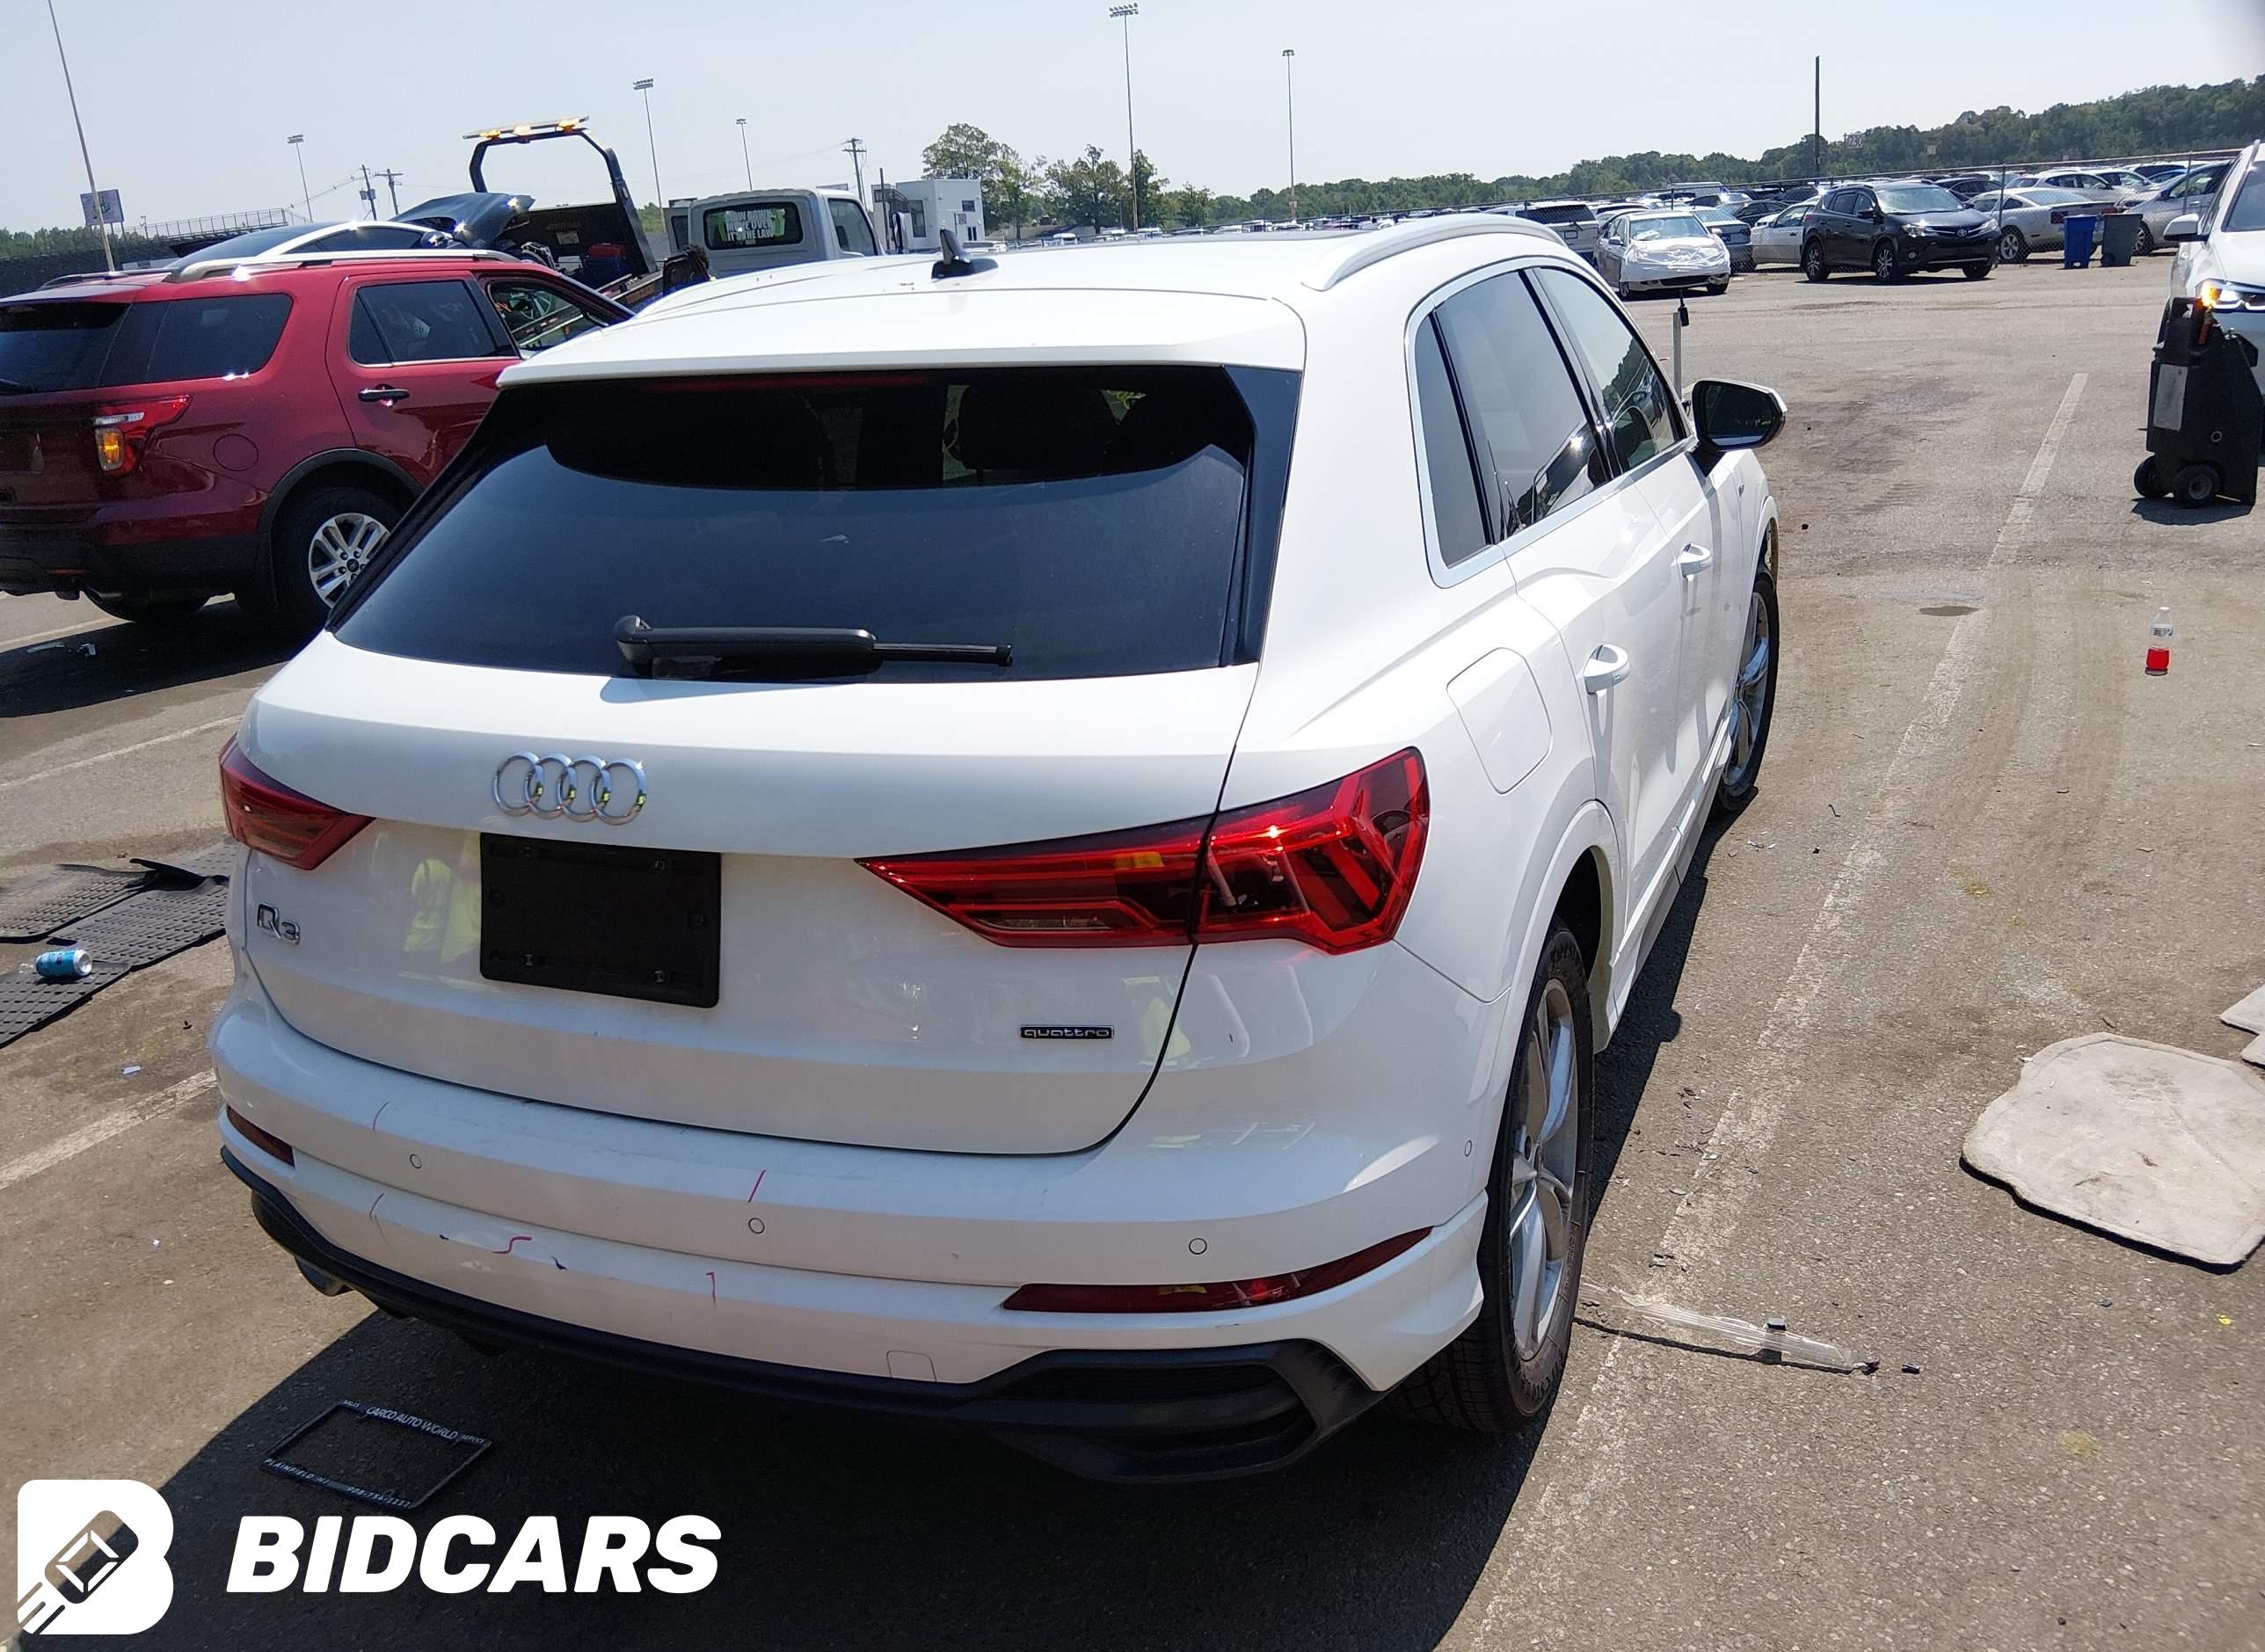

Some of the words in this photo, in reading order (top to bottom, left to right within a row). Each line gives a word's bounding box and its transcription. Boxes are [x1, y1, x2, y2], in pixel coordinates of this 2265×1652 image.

[257, 901, 302, 945] Q3
[1023, 1028, 1111, 1038] quattro
[366, 1407, 397, 1419] CARCO
[394, 1414, 423, 1427] AUTO
[421, 1421, 458, 1439] WORLD
[264, 1458, 315, 1479] PLAINFIELD
